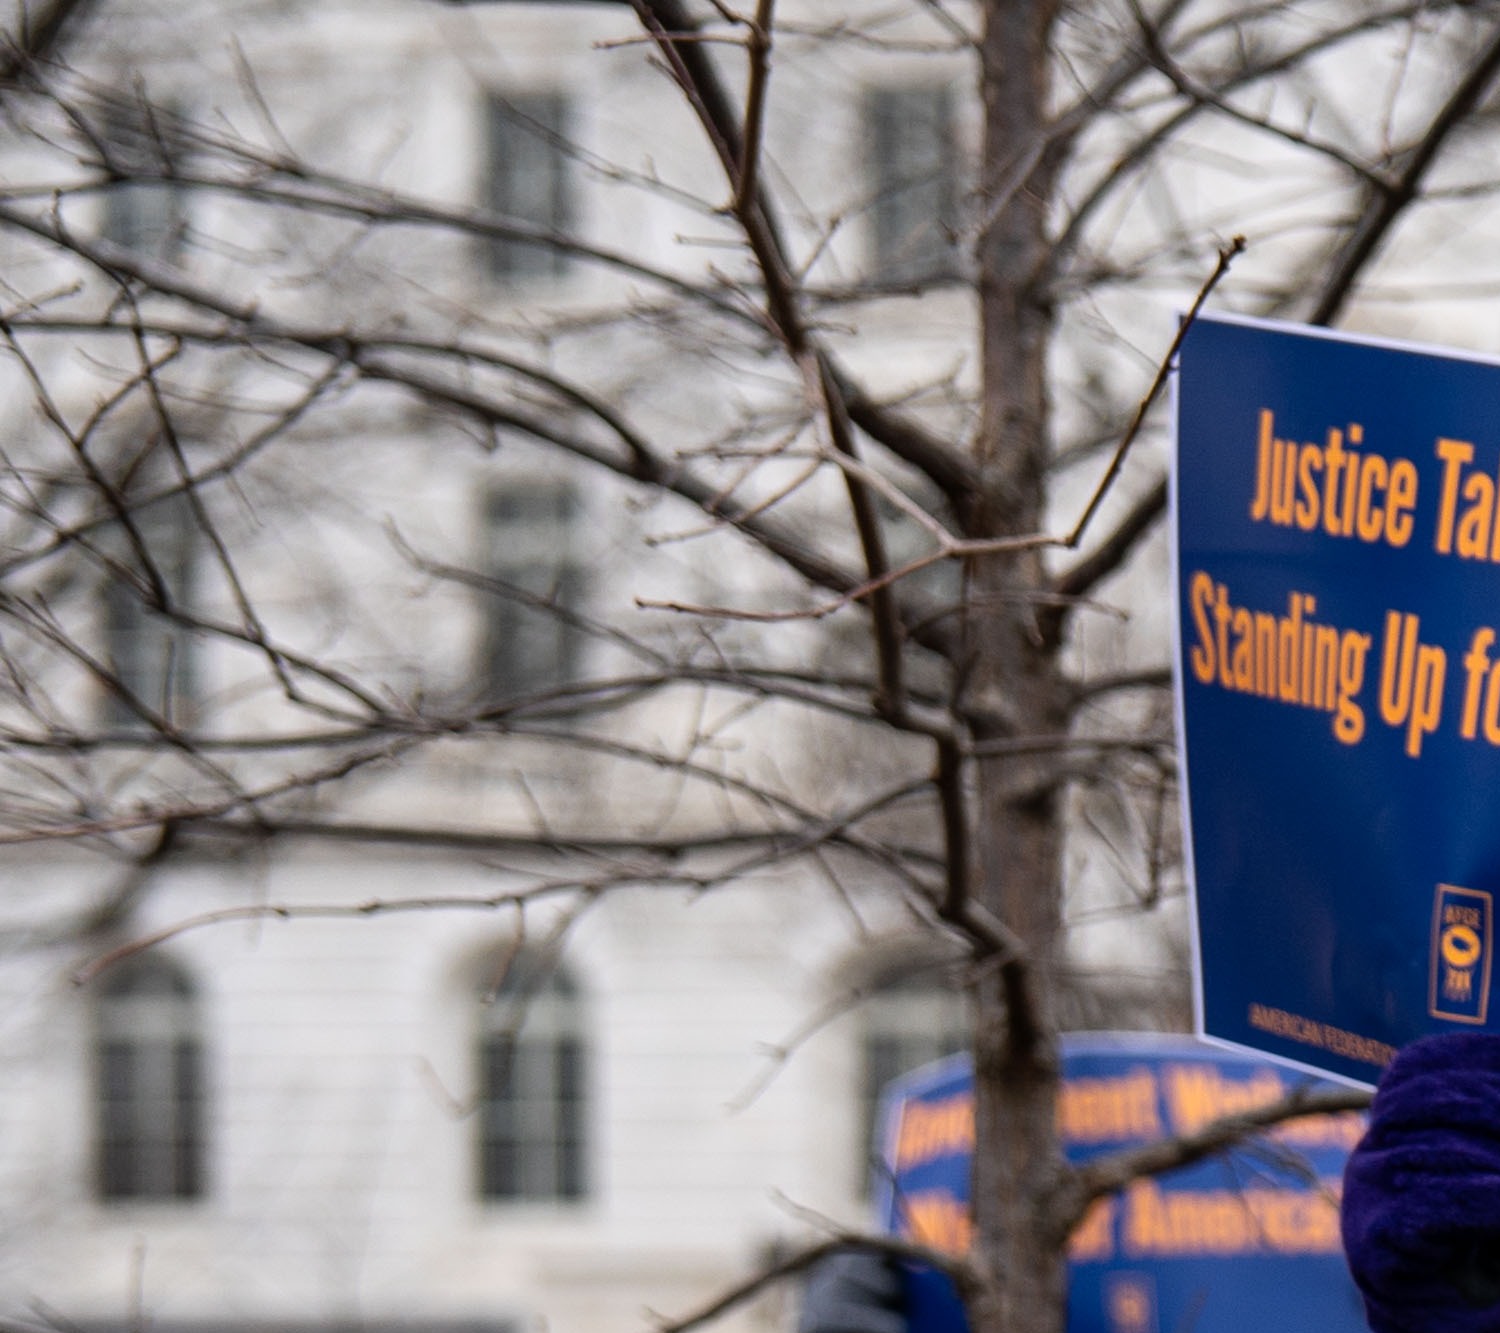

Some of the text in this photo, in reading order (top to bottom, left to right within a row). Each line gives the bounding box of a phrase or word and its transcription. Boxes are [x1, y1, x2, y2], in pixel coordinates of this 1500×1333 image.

[1252, 410, 1417, 546] Justice
[1192, 573, 1371, 744] Standing
[1380, 612, 1446, 756] Up
[1248, 1002, 1324, 1048] AMERICAN
